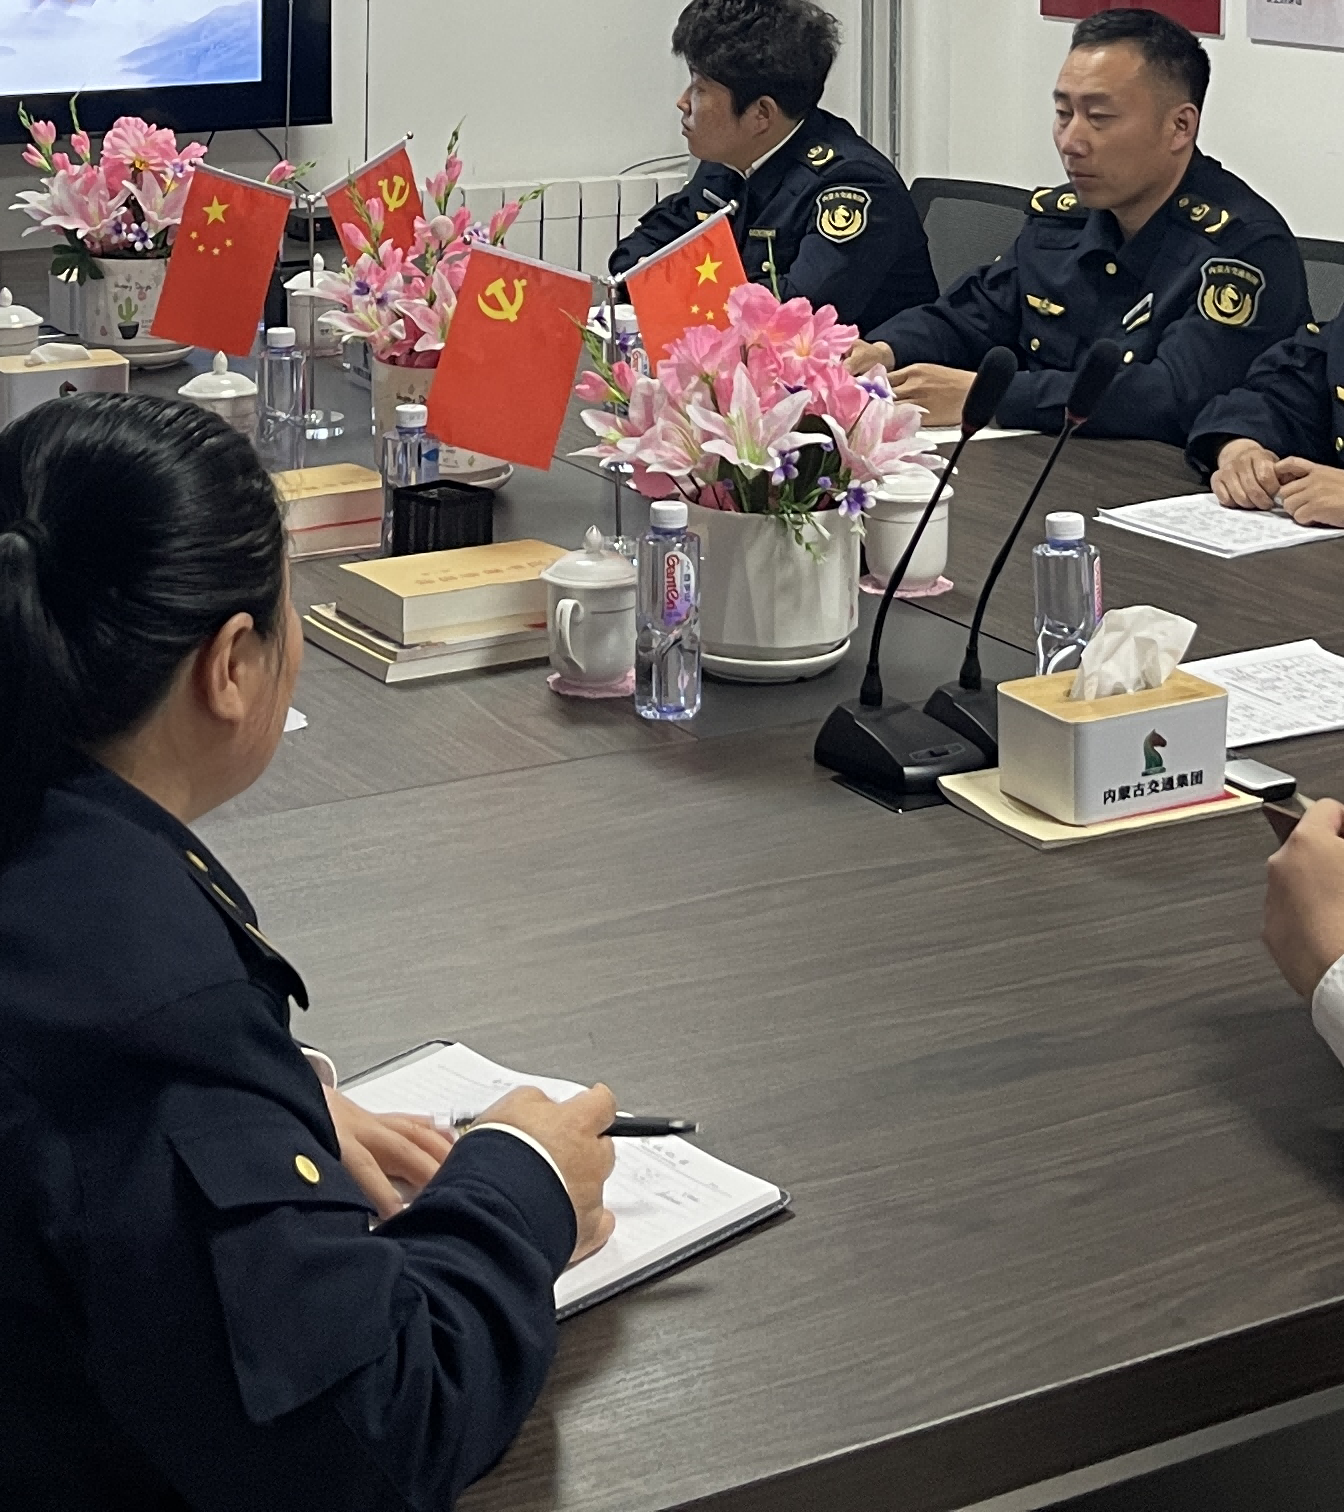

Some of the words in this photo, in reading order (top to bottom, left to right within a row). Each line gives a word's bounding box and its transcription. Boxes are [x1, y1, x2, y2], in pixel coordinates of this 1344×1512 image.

[1103, 769, 1203, 805] 内蒙古交通集团
